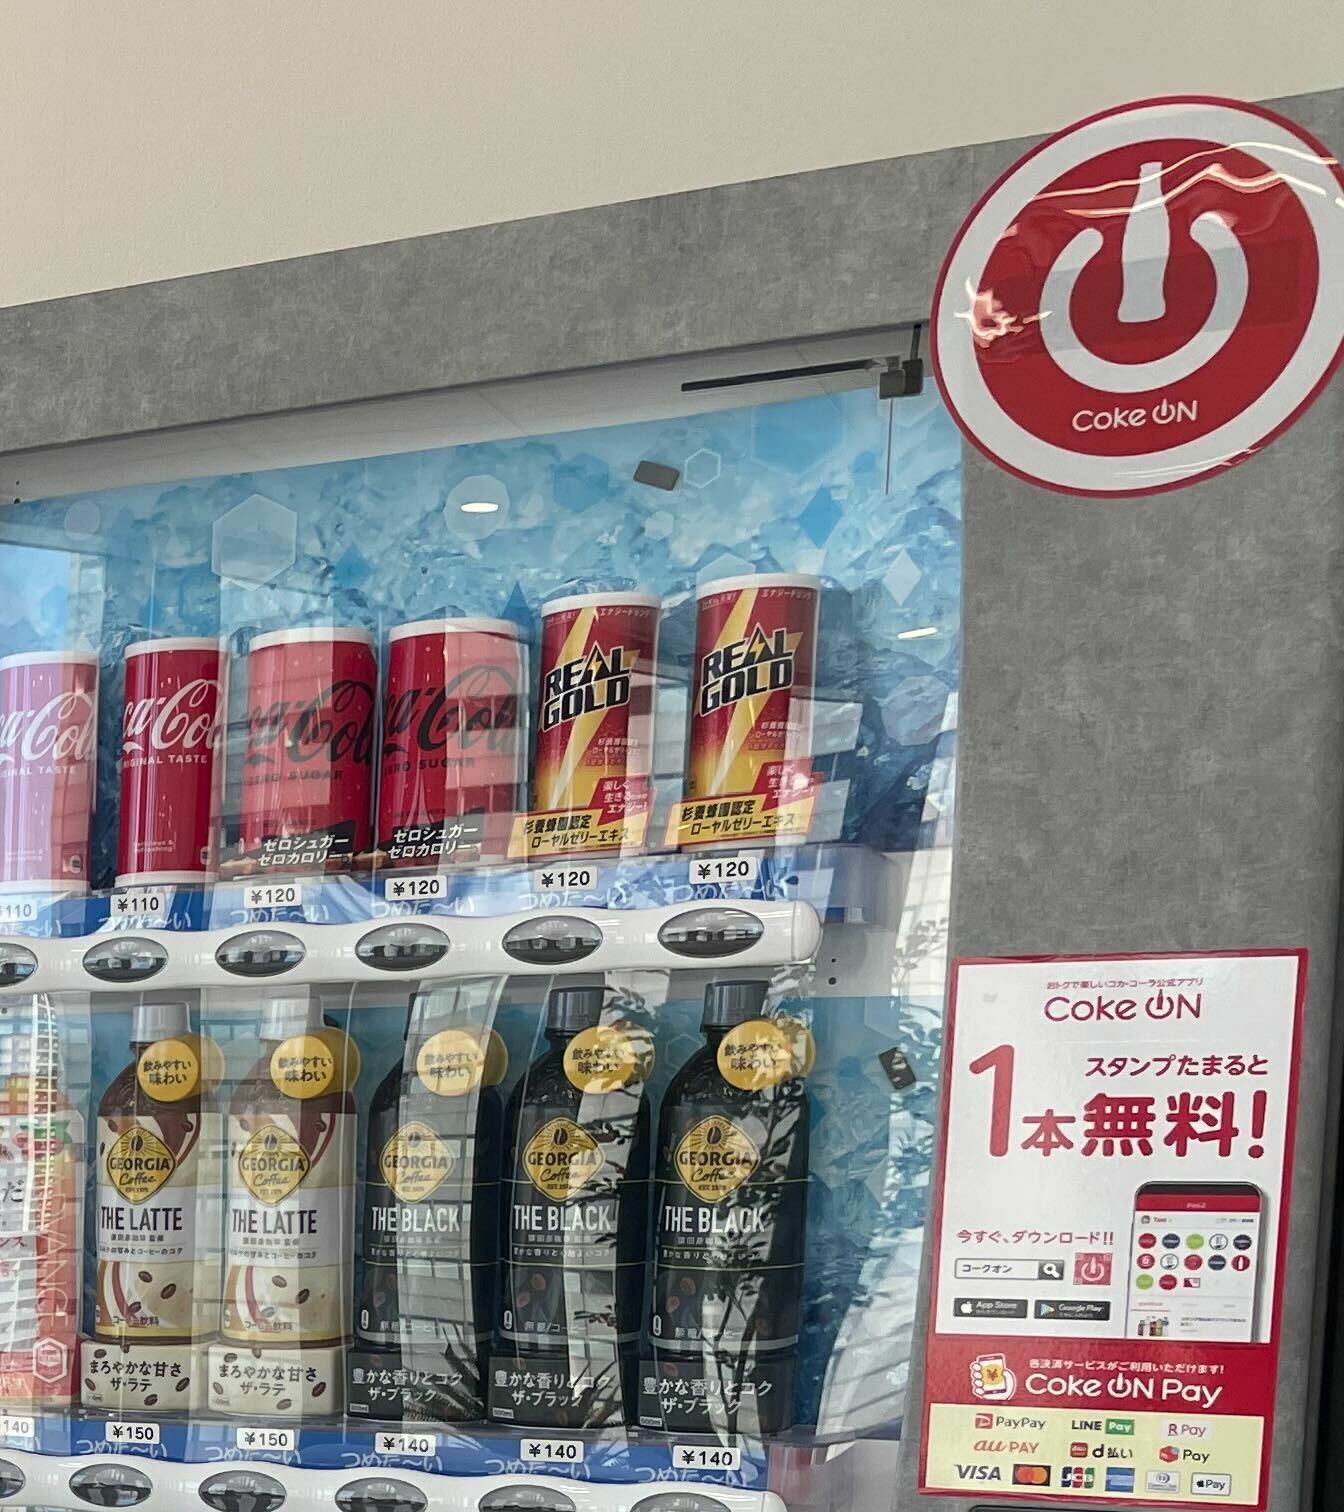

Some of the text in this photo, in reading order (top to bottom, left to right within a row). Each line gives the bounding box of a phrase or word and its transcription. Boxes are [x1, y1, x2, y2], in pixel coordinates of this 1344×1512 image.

[1072, 398, 1198, 432] Coke ON
[702, 622, 788, 683] REAL
[544, 640, 630, 703] REAL
[701, 658, 793, 717] GOLD
[543, 677, 630, 731] GOLD
[691, 812, 795, 835] ローヤルゼリーエキス
[264, 834, 349, 852] ゼロシュガー
[697, 861, 750, 878] ¥120
[541, 871, 590, 887] ¥120
[393, 880, 440, 896] ¥120
[118, 897, 159, 912] ¥110
[1044, 988, 1202, 1022] Coke ON
[144, 1059, 191, 1072] 飲みやすい
[1085, 1055, 1269, 1077] スタンプたまると
[148, 1071, 187, 1085] 味わい
[109, 1157, 170, 1171] GEORGIA
[679, 1149, 752, 1166] GEORGIA
[119, 1172, 156, 1186] Coffee
[101, 1207, 182, 1232] THE LATTE
[232, 1209, 317, 1234] THE LATTE
[514, 1205, 610, 1231] THE BLACK
[665, 1205, 765, 1233] THE BLACK
[961, 1264, 1012, 1274] コークオン
[90, 1361, 182, 1376] まろやかな甘さ
[642, 1379, 772, 1396] 豊かな香りとコク
[1025, 1373, 1222, 1408] Coke ON Pay
[996, 1417, 1045, 1429] PayPay
[1071, 1420, 1132, 1432] LINE Pay
[113, 1426, 154, 1440] ¥150
[974, 1442, 1039, 1453] au PAY
[682, 1450, 733, 1465] ¥140
[954, 1465, 1002, 1481] VISA
